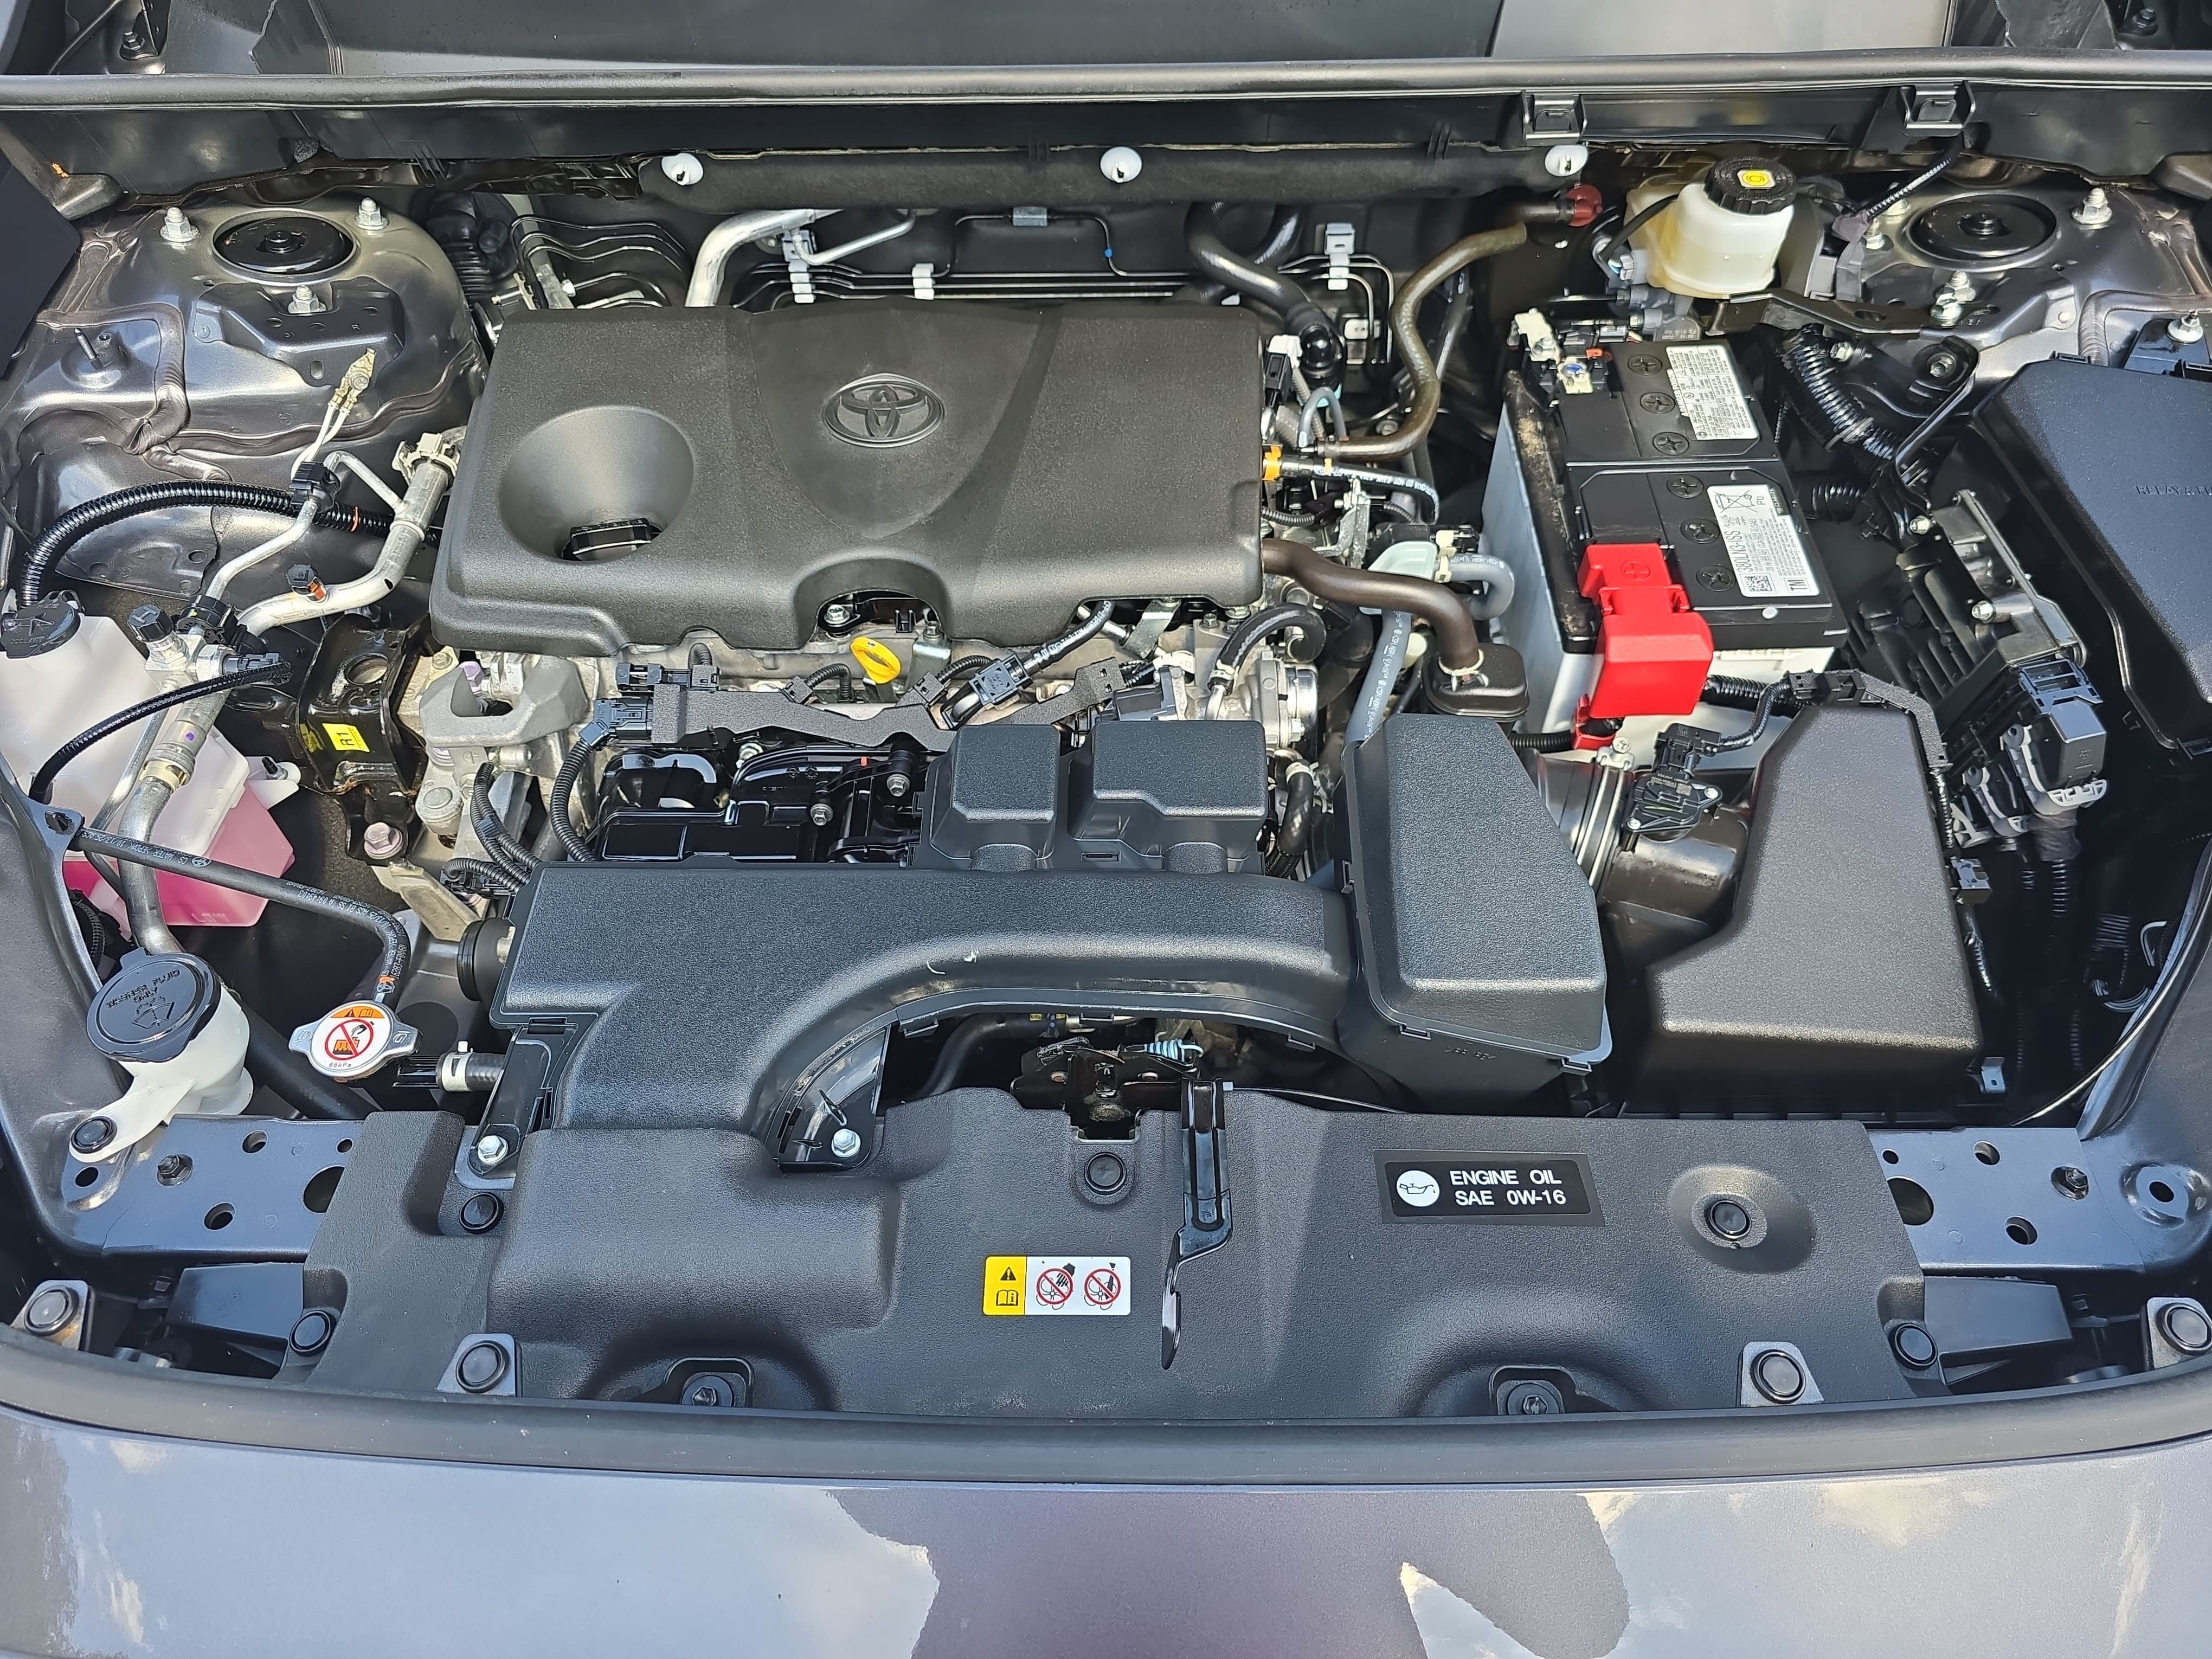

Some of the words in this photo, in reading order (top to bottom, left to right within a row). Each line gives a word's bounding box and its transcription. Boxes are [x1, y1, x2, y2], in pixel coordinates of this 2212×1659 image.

[2136, 485, 2181, 496] RELAY
[1724, 530, 1754, 573] 380LN3-ISS
[1787, 580, 1808, 591] TM
[131, 607, 158, 624] H
[336, 732, 355, 745] R1
[94, 834, 126, 847] 10/13/25
[153, 850, 175, 861] WATER
[298, 890, 328, 906] 09:49:03
[385, 949, 397, 965] WATER
[390, 944, 408, 980] 16283-F0060
[106, 984, 147, 1008] WASHER
[152, 969, 180, 986] FLUID
[1450, 1170, 1519, 1185] ENGINE
[1529, 1169, 1562, 1184] OIL
[1455, 1190, 1495, 1206] SAE
[1507, 1189, 1566, 1205] 0W-16
